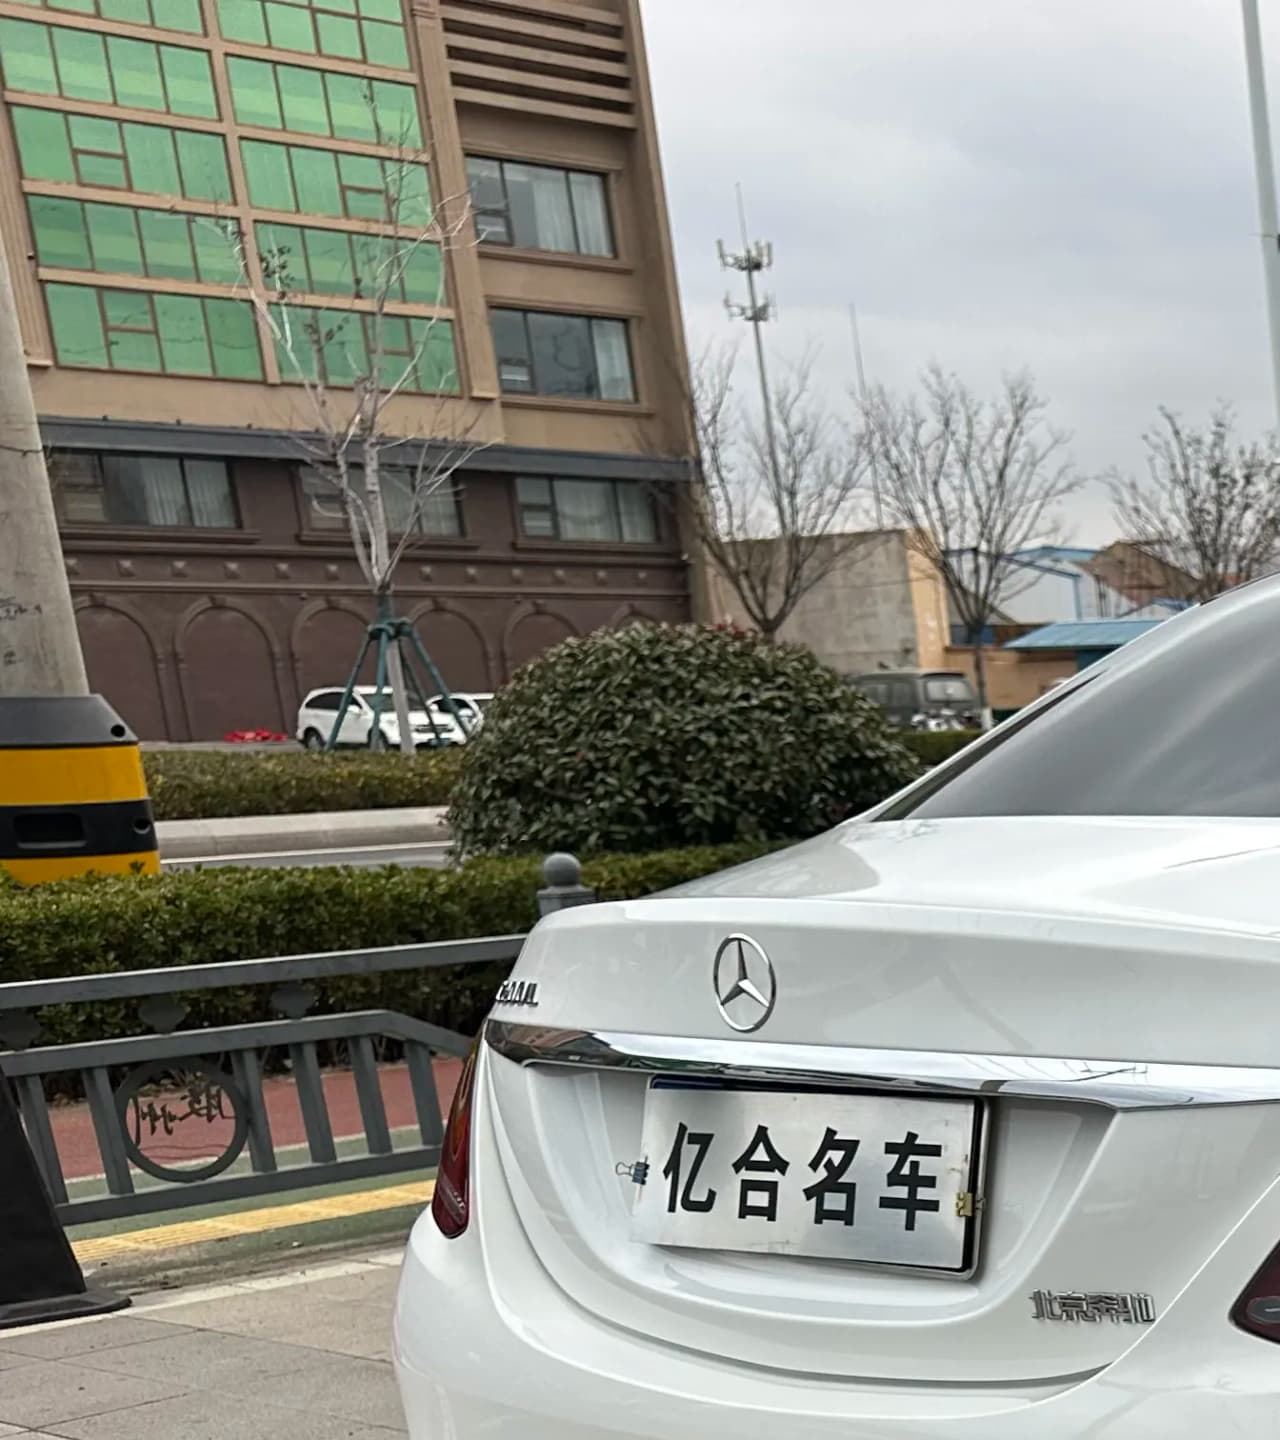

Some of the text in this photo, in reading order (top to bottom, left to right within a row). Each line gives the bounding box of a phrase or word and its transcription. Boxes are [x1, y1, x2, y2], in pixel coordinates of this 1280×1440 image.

[662, 1121, 943, 1231] 亿合名车
[1030, 1289, 1155, 1324] 北京奔驰
